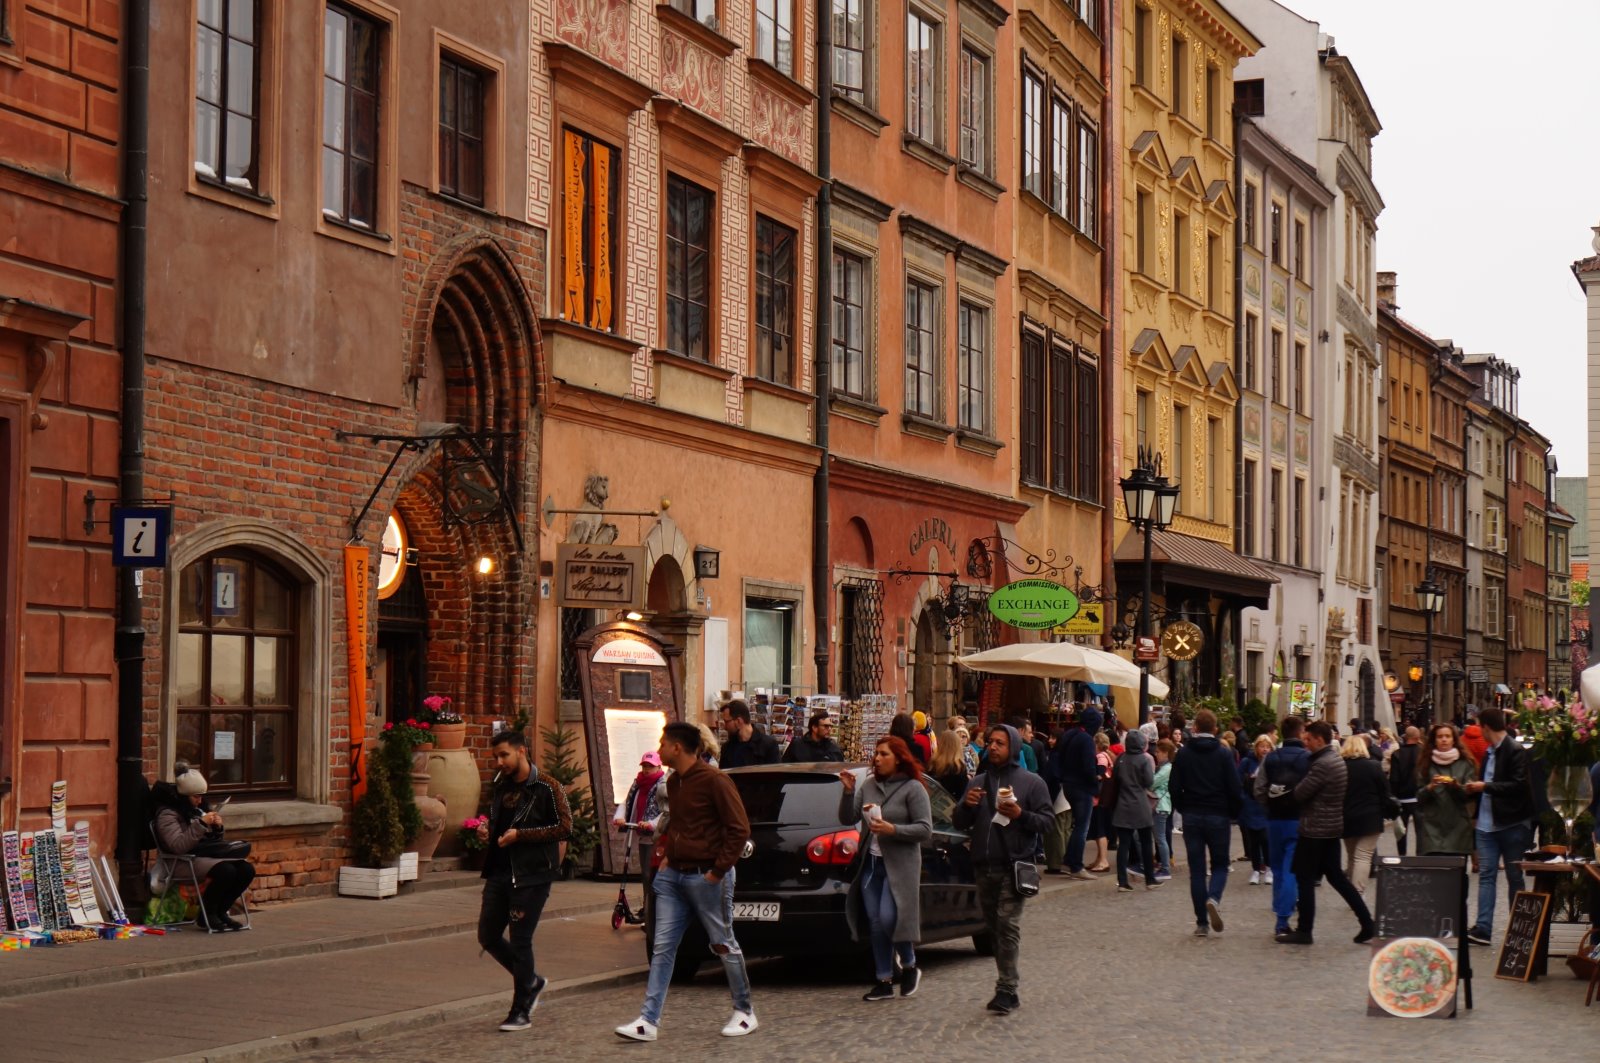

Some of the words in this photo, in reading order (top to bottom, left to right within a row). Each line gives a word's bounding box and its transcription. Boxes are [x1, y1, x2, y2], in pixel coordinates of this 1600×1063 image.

[910, 517, 957, 562] GALERIA
[702, 560, 713, 569] 21
[569, 565, 586, 574] ART
[591, 565, 630, 577] GALLERY
[1008, 583, 1017, 592] NO
[1018, 581, 1060, 592] COMMISSION
[356, 559, 364, 633] ILLUSION
[997, 599, 1070, 610] EXCHANGE
[1008, 618, 1018, 626] NO
[1018, 619, 1058, 629] COMMISSION
[602, 649, 632, 659] WARSAW
[632, 651, 657, 660] CUISINE
